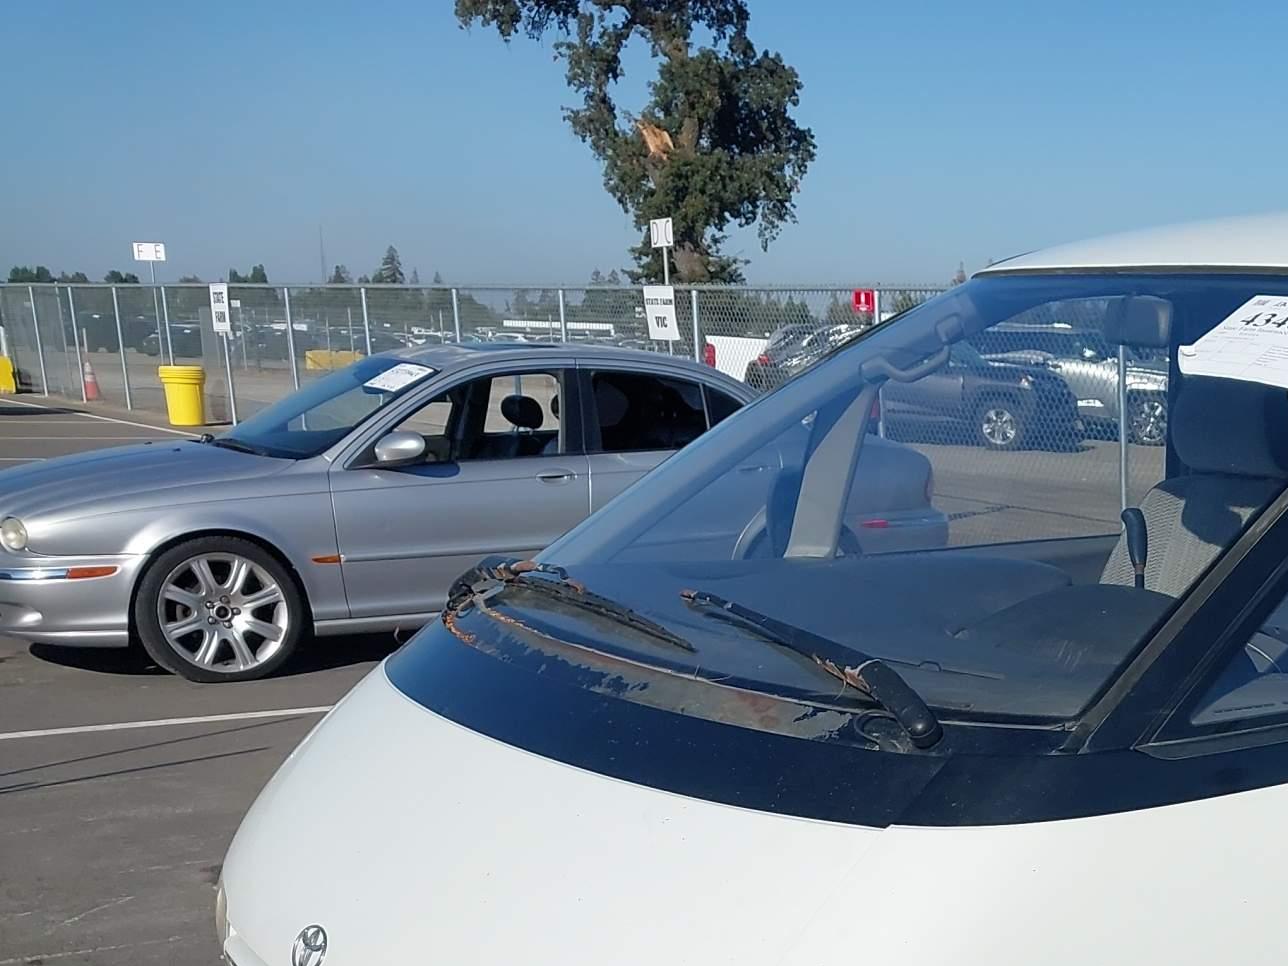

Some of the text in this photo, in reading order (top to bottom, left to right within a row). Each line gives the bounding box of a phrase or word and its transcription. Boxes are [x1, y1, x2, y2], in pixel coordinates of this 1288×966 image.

[136, 244, 162, 260] F E
[645, 298, 673, 306] STATE FARM
[654, 315, 668, 328] VIC
